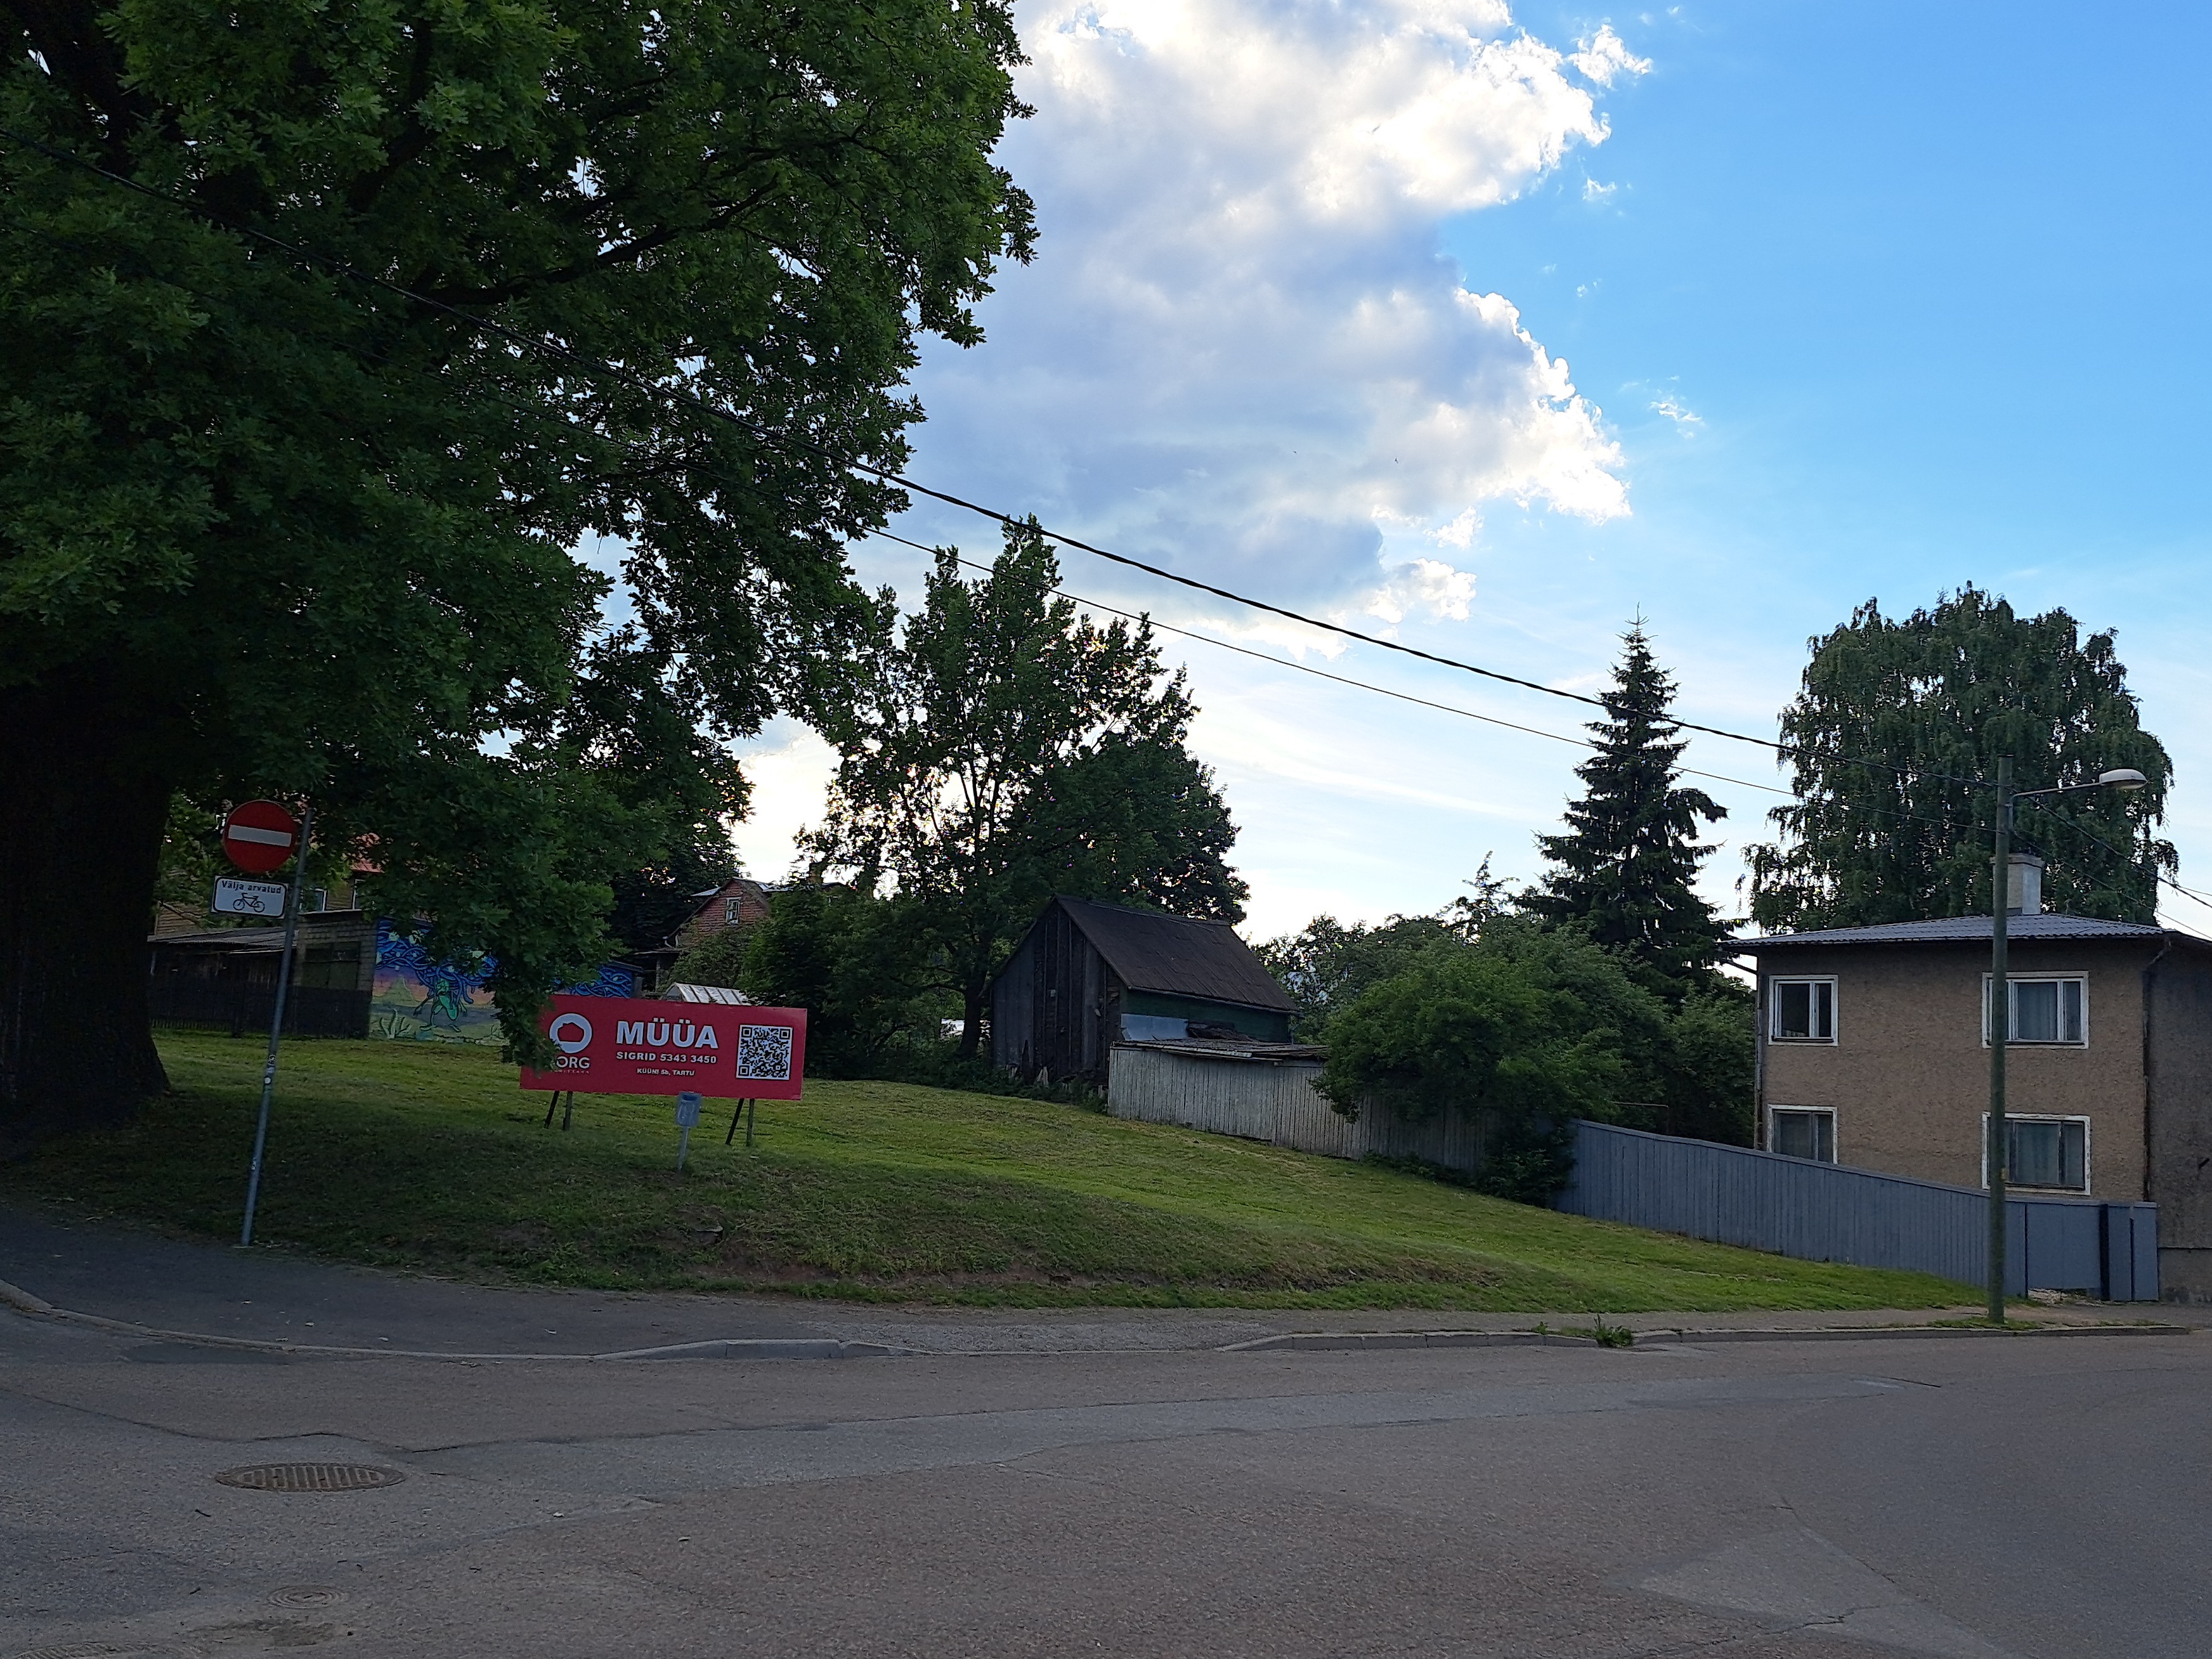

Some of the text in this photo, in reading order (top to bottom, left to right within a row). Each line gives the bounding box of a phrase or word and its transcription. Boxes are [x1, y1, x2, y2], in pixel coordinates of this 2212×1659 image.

[222, 880, 282, 894] Välja arvatud
[616, 1017, 719, 1049] MÜÜA
[550, 1055, 590, 1069] ORG
[616, 1051, 717, 1064] SIGRID 5343 3450
